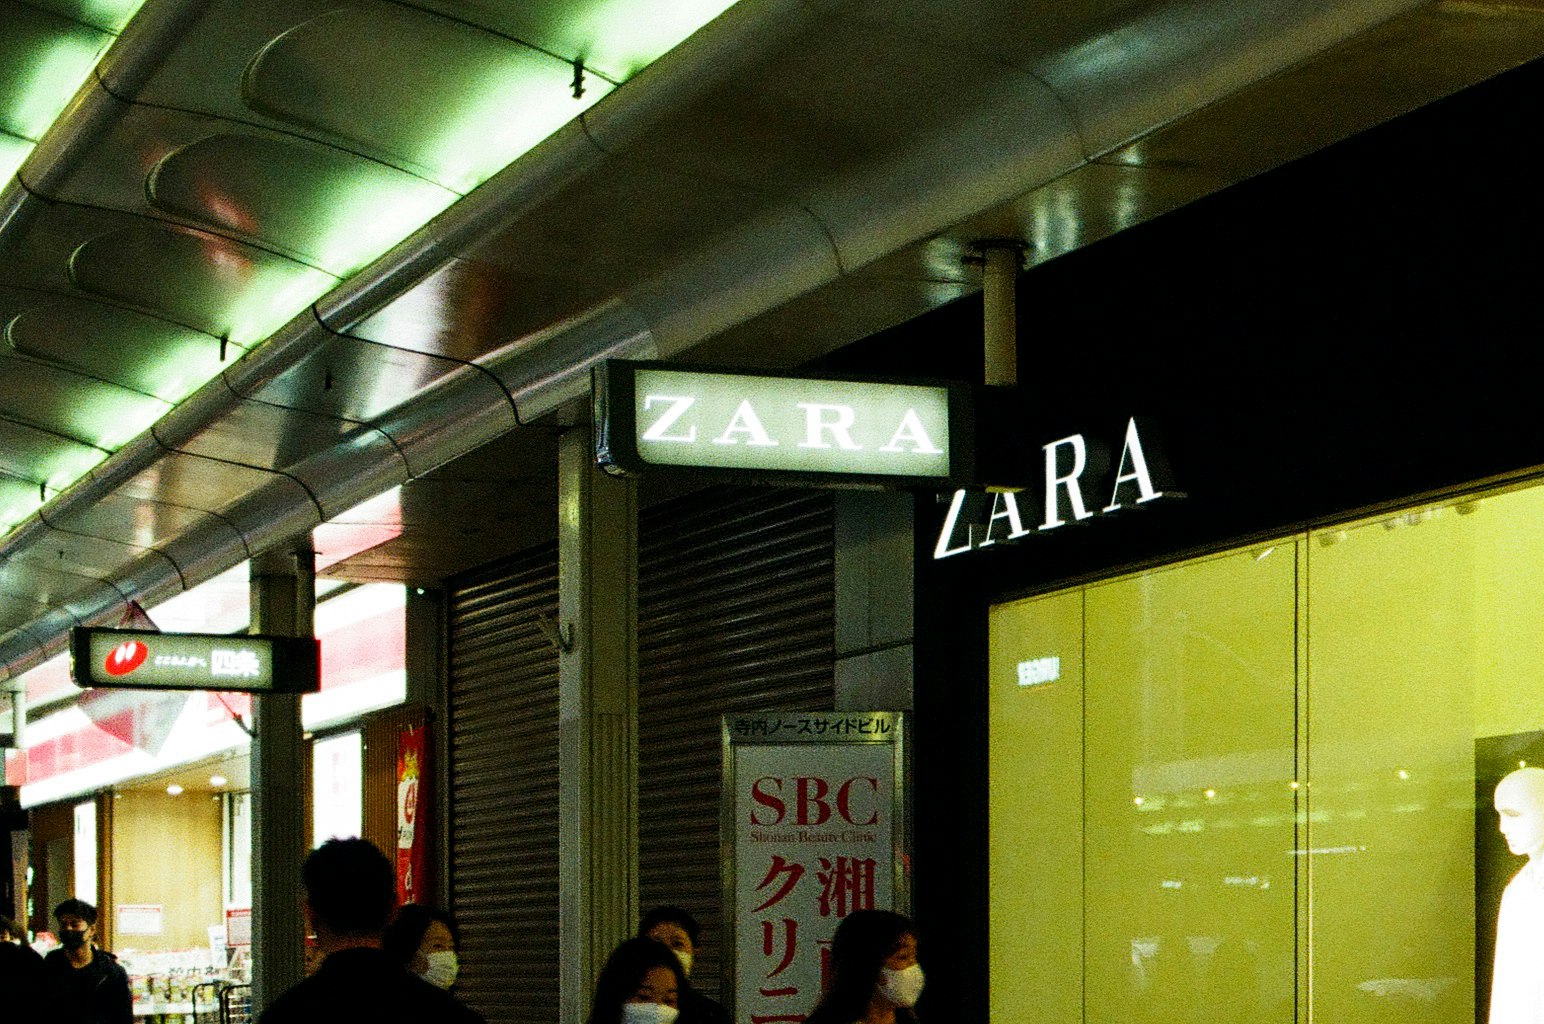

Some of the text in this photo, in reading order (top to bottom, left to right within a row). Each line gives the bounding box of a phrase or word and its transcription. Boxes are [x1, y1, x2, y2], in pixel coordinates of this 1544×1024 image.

[642, 395, 944, 454] ZARA
[933, 415, 1164, 560] ZARA
[735, 718, 891, 735] 寺内ノースサイドビル
[751, 776, 878, 826] SBC
[751, 830, 877, 843] Shonan Beauty Clinic
